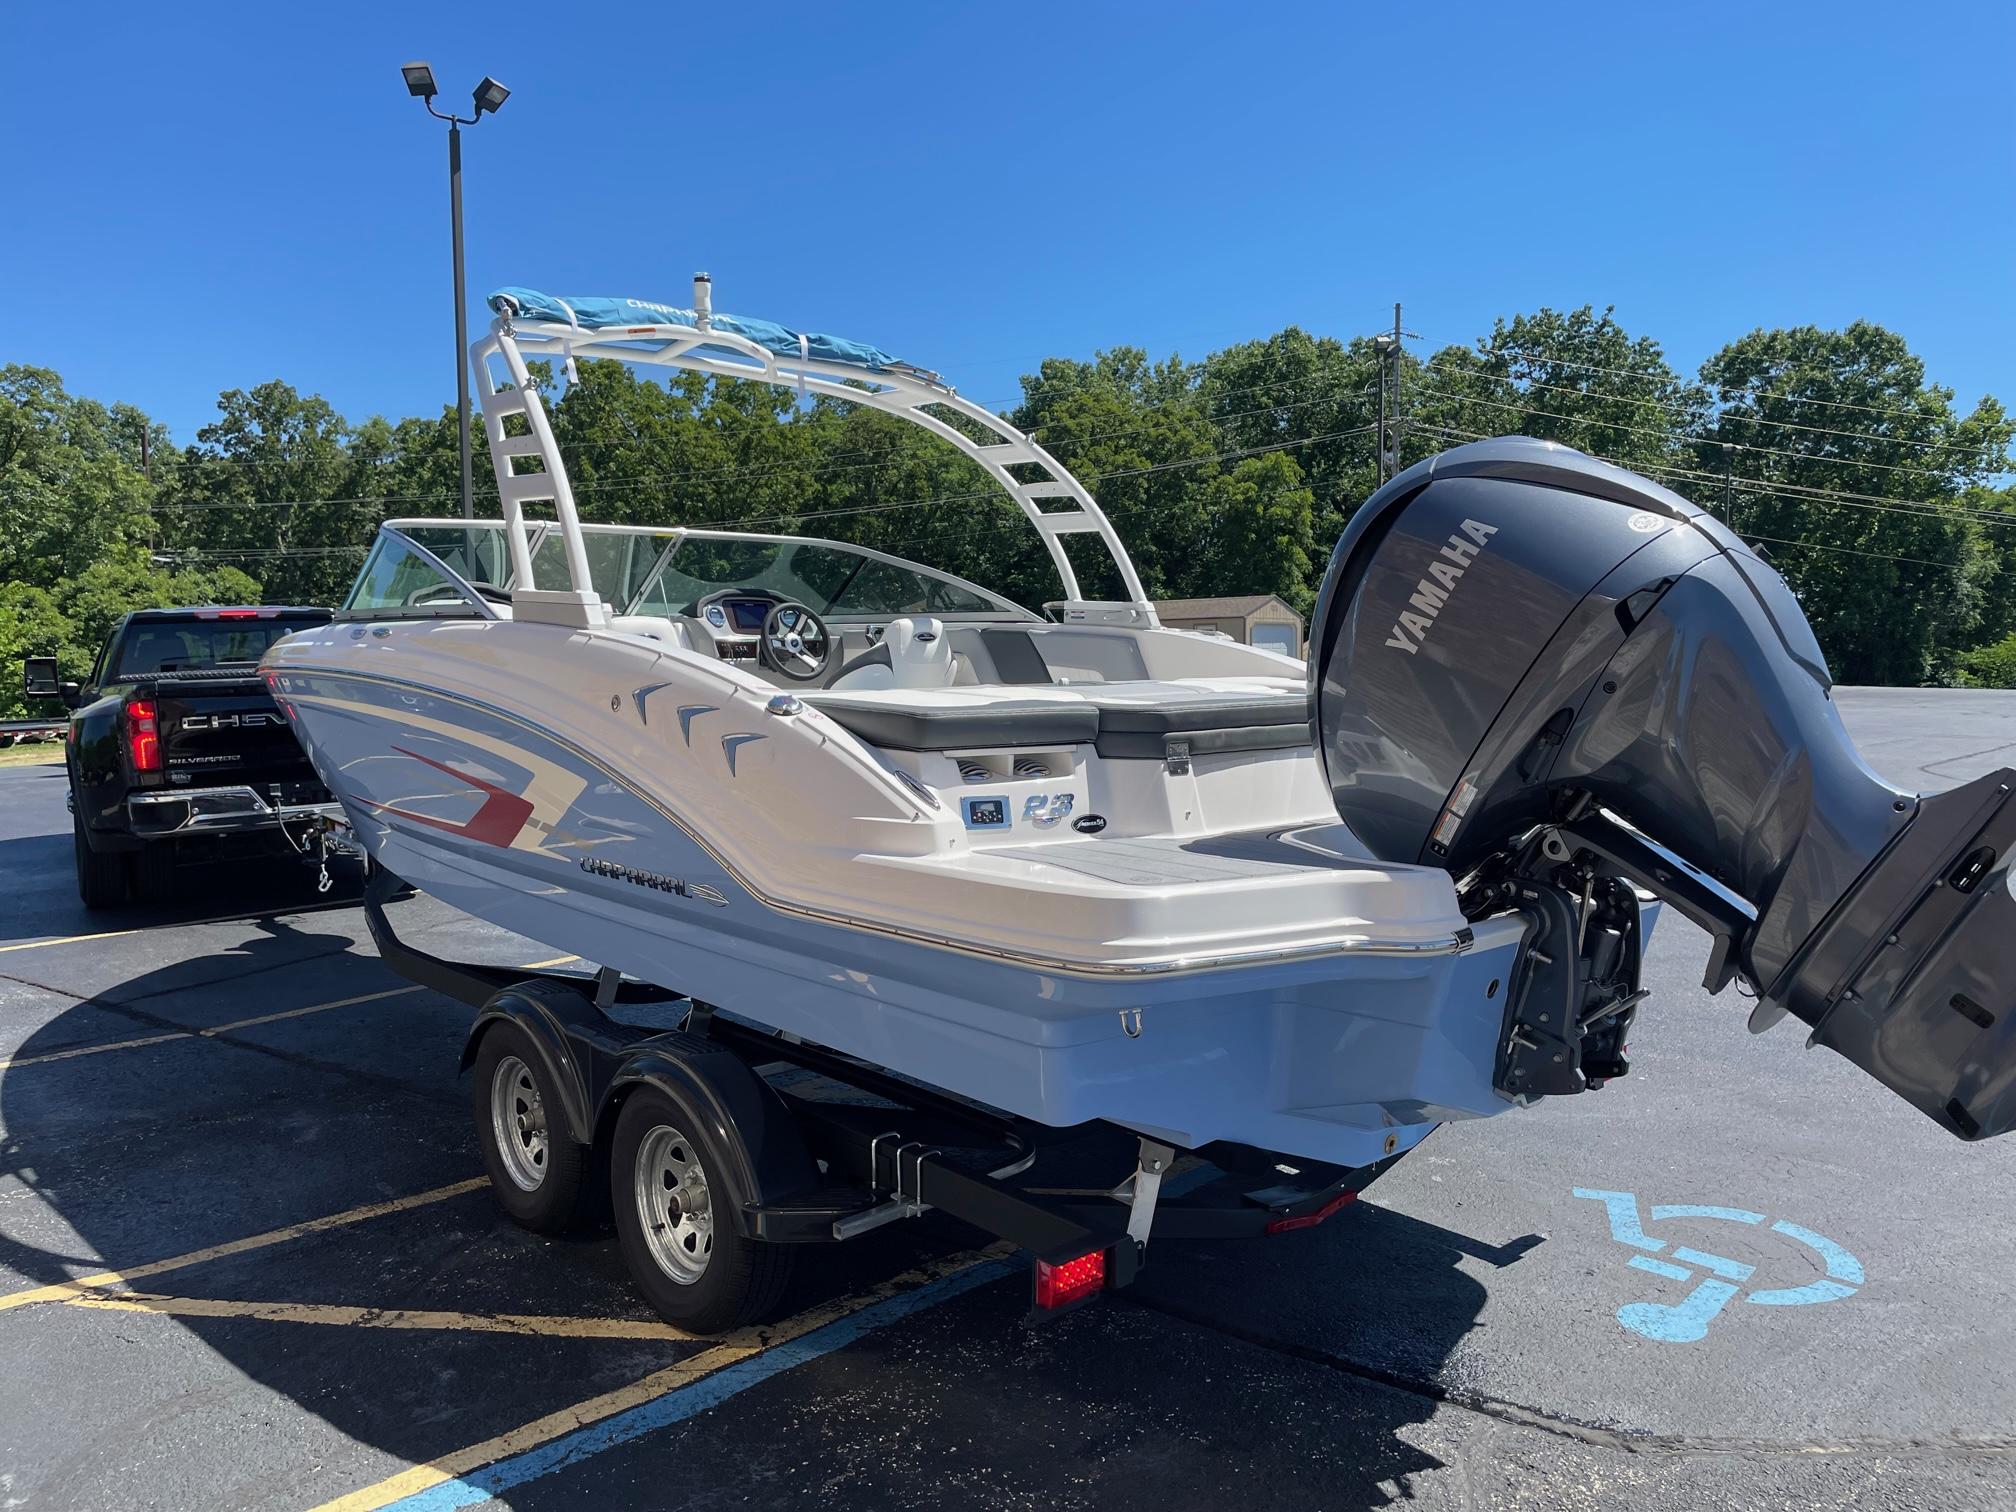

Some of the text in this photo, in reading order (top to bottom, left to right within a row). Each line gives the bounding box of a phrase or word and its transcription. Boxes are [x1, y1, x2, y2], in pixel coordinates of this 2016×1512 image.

[1385, 519, 1498, 654] YAMAHA
[169, 755, 240, 764] SILVERADO
[580, 856, 692, 898] CHAPARRAL
